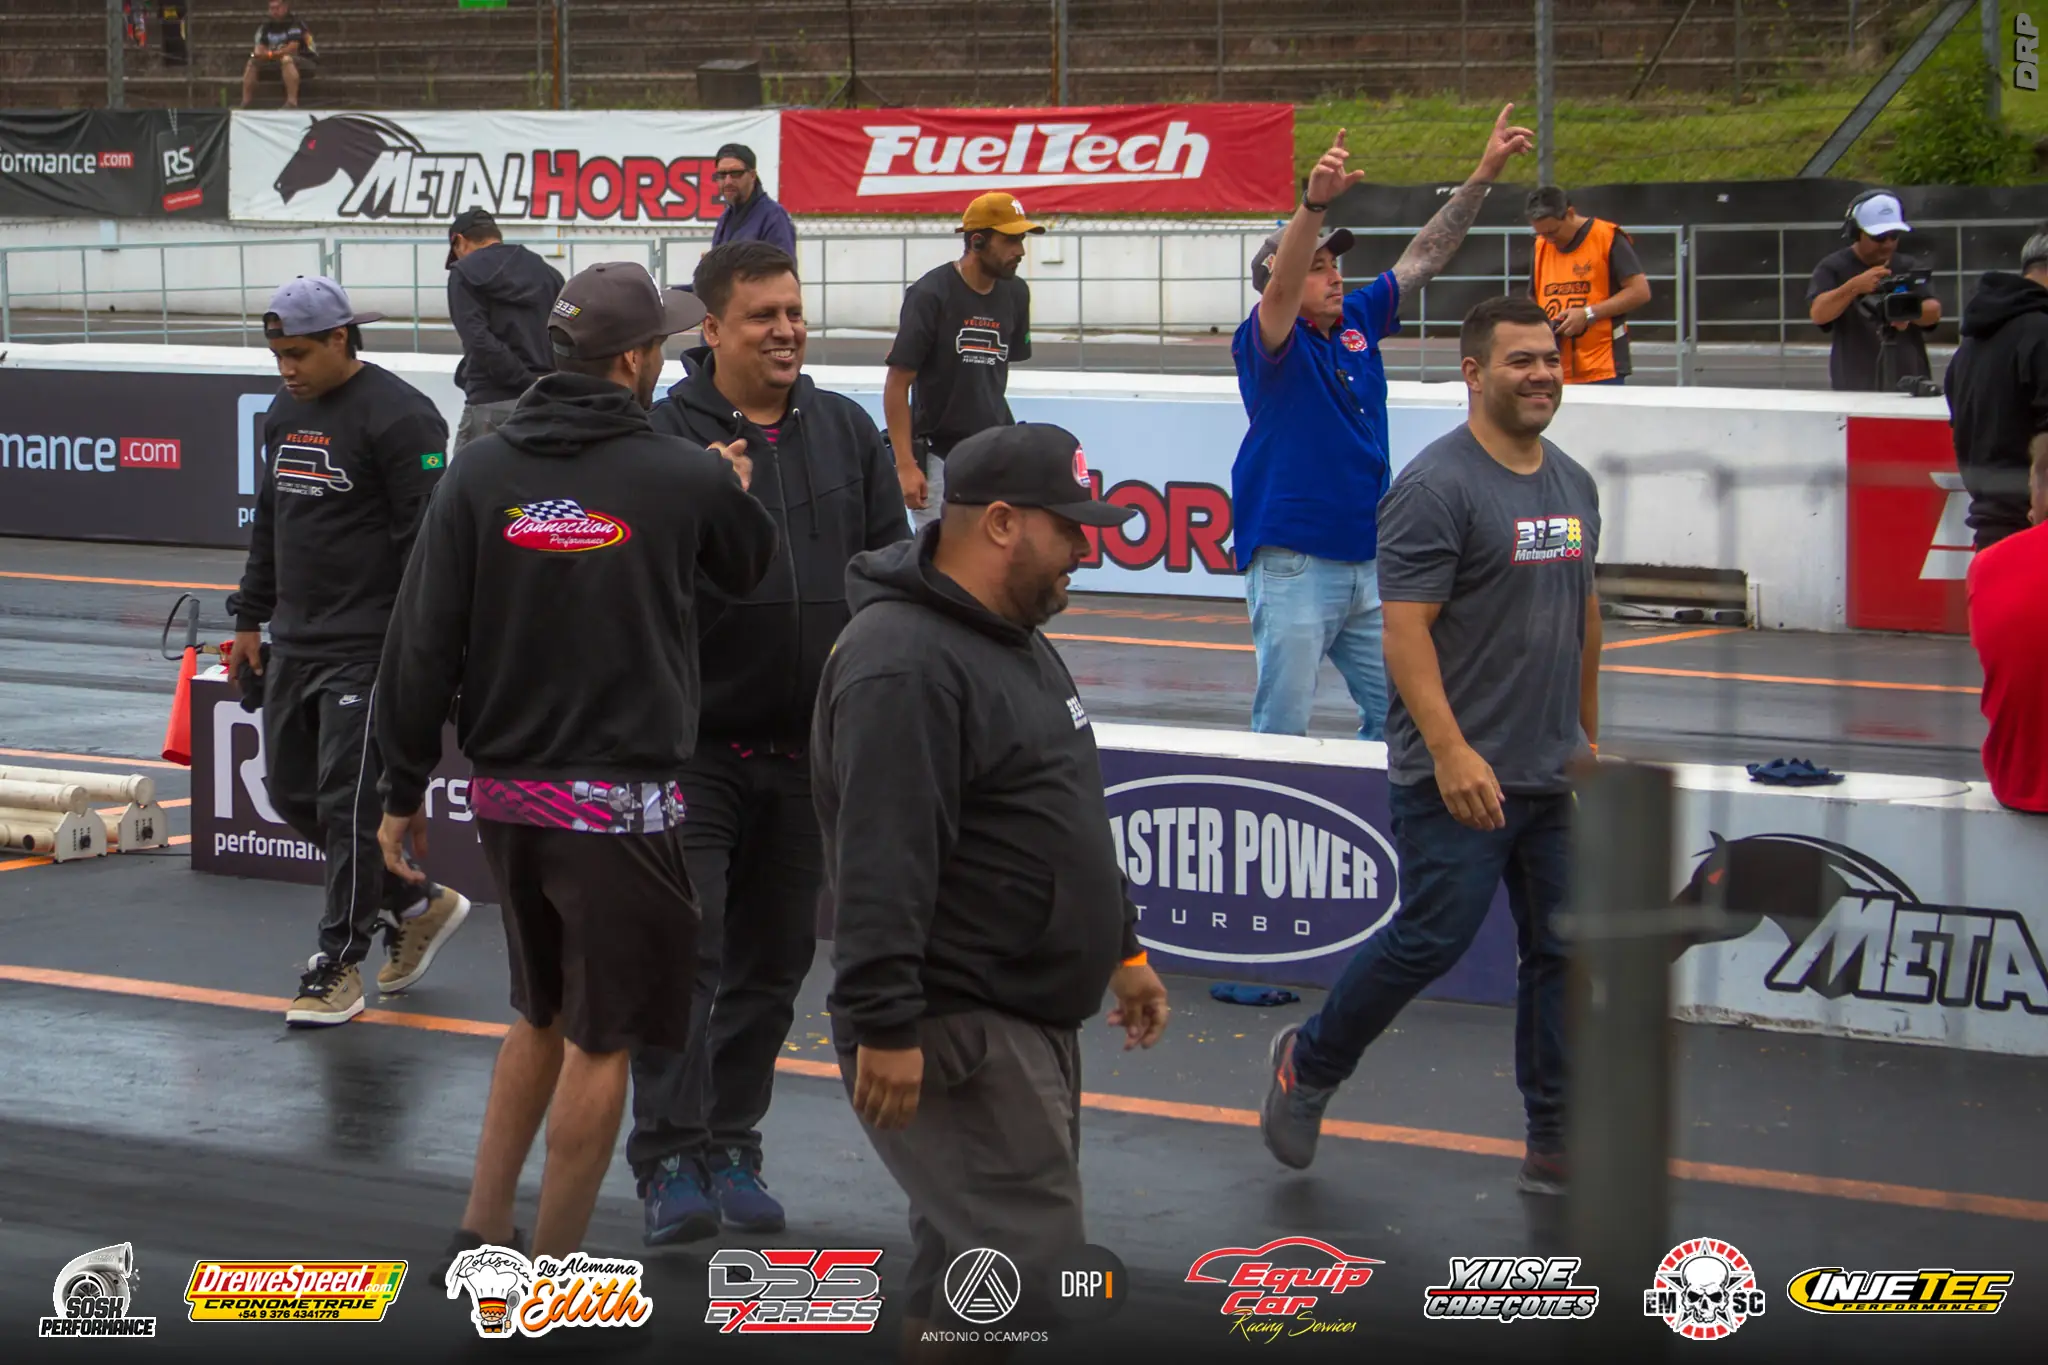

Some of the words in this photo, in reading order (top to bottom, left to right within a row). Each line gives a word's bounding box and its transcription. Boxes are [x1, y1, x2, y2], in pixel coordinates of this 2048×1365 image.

[163, 146, 195, 177] RS
[862, 121, 1209, 179] FuelTech
[286, 433, 332, 446] VELOPARK
[507, 514, 614, 538] Connection
[549, 534, 605, 547] Performance
[214, 830, 327, 861] performan
[1109, 807, 1223, 894] ASTER
[1235, 809, 1378, 899] POWER
[1135, 905, 1311, 936] TURBO
